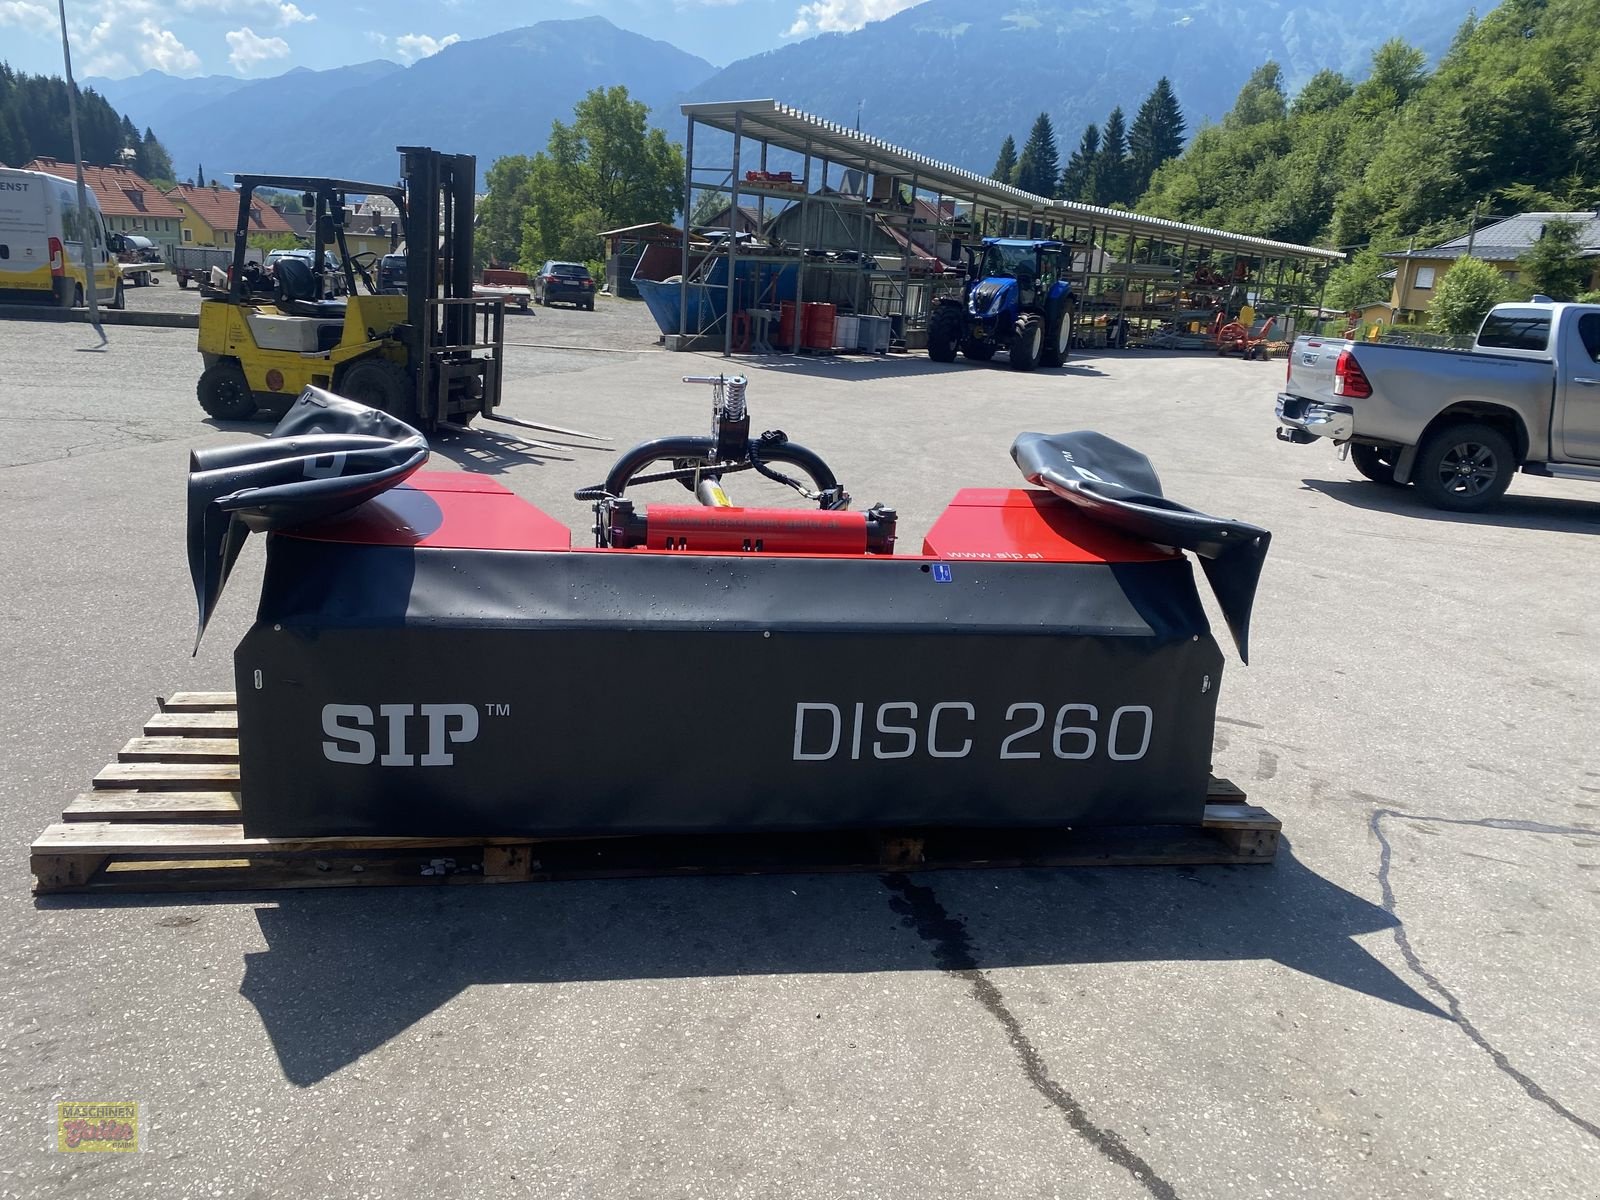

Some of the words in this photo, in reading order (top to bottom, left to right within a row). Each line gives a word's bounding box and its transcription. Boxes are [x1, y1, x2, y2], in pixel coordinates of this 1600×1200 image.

[0, 182, 29, 192] ENST
[946, 551, 1044, 560] www.sip.si
[321, 702, 479, 767] SIP
[793, 701, 976, 761] DISC
[1000, 702, 1153, 762] 260
